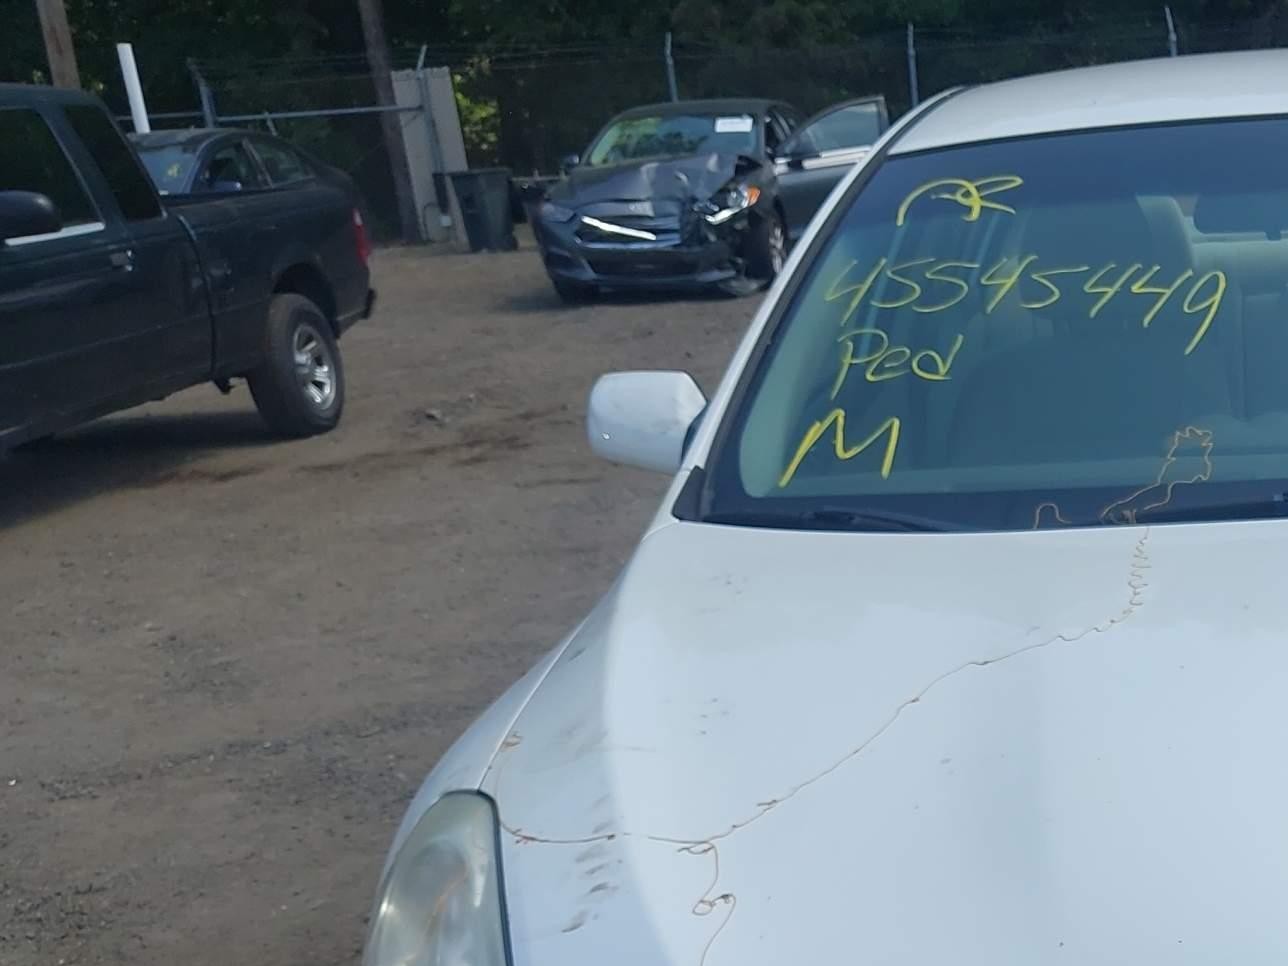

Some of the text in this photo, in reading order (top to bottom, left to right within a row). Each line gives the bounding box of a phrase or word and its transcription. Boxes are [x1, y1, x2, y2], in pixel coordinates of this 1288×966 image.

[825, 255, 1227, 355] 45545449
[832, 329, 964, 399] Ped
[778, 408, 900, 488] M
